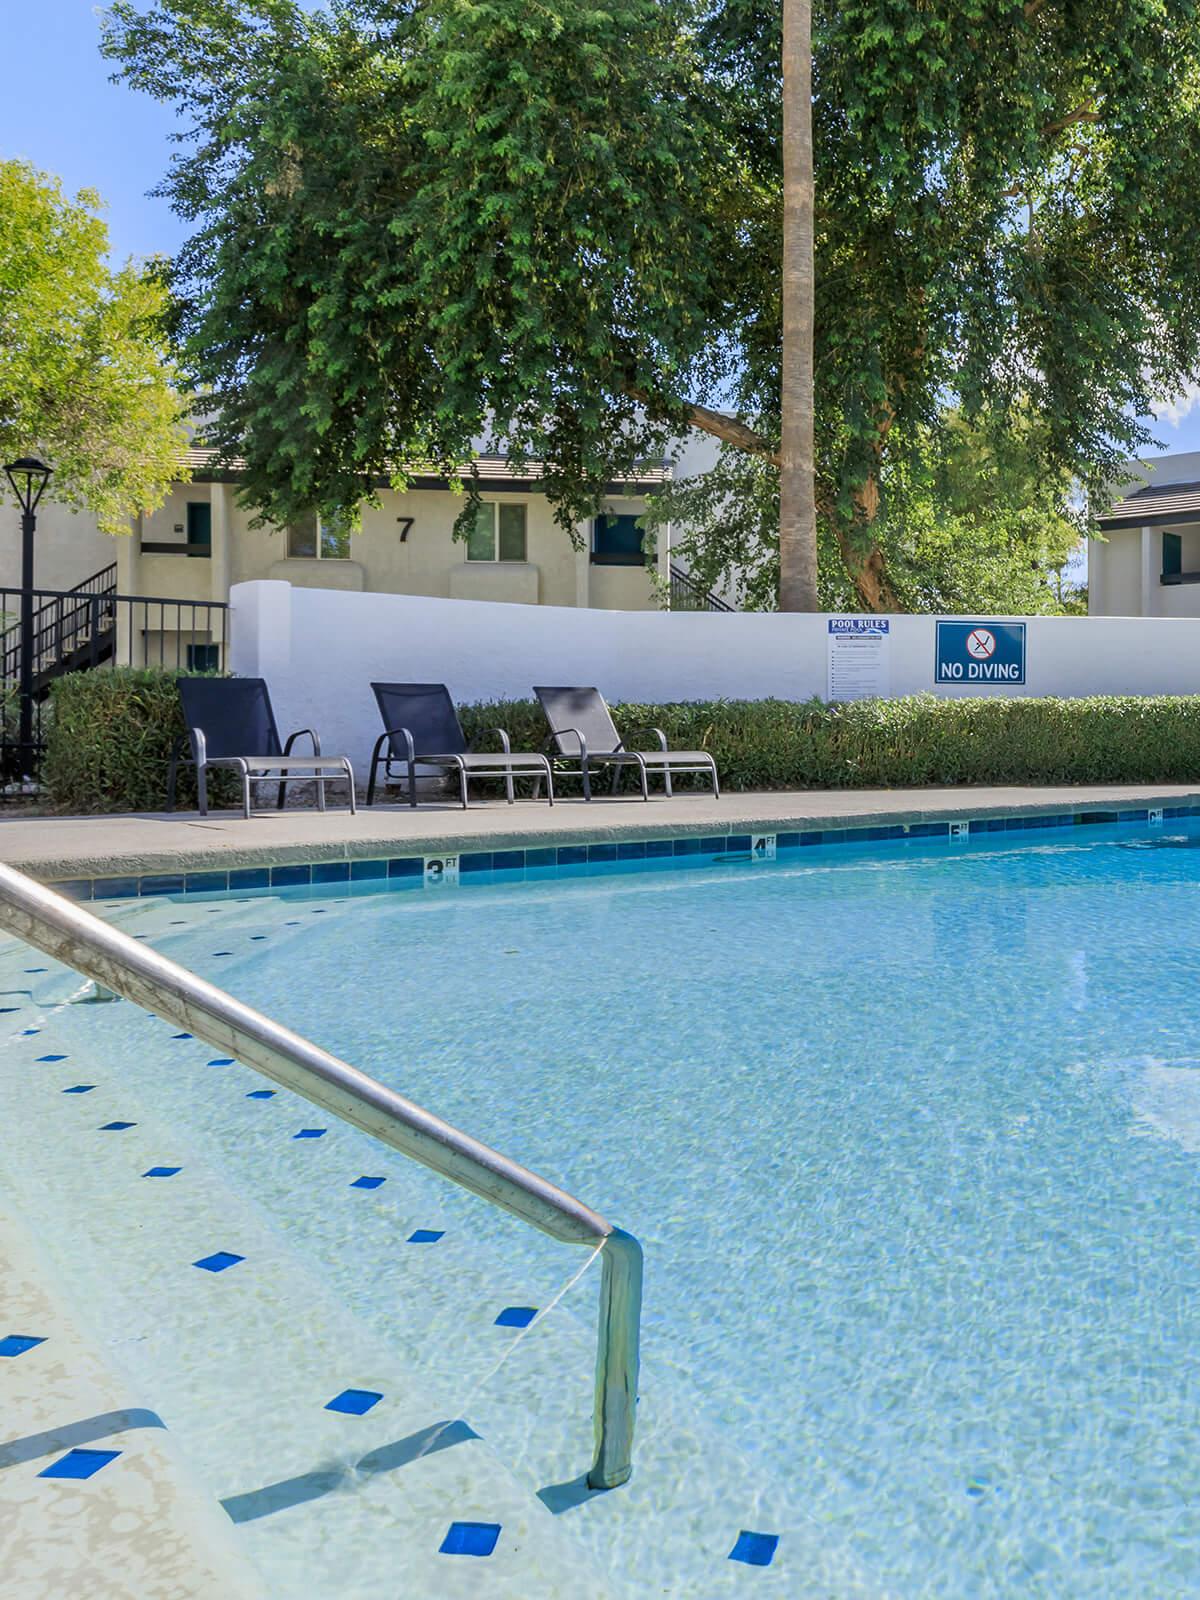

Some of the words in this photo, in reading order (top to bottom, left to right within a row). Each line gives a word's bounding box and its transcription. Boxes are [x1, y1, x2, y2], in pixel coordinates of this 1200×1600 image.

[397, 517, 415, 542] 7
[831, 620, 854, 628] POOL
[858, 620, 886, 628] RULES
[941, 662, 963, 678] NO
[968, 663, 1019, 679] DIVING
[767, 836, 775, 845] FT
[427, 860, 443, 873] 3
[446, 858, 456, 867] FT
